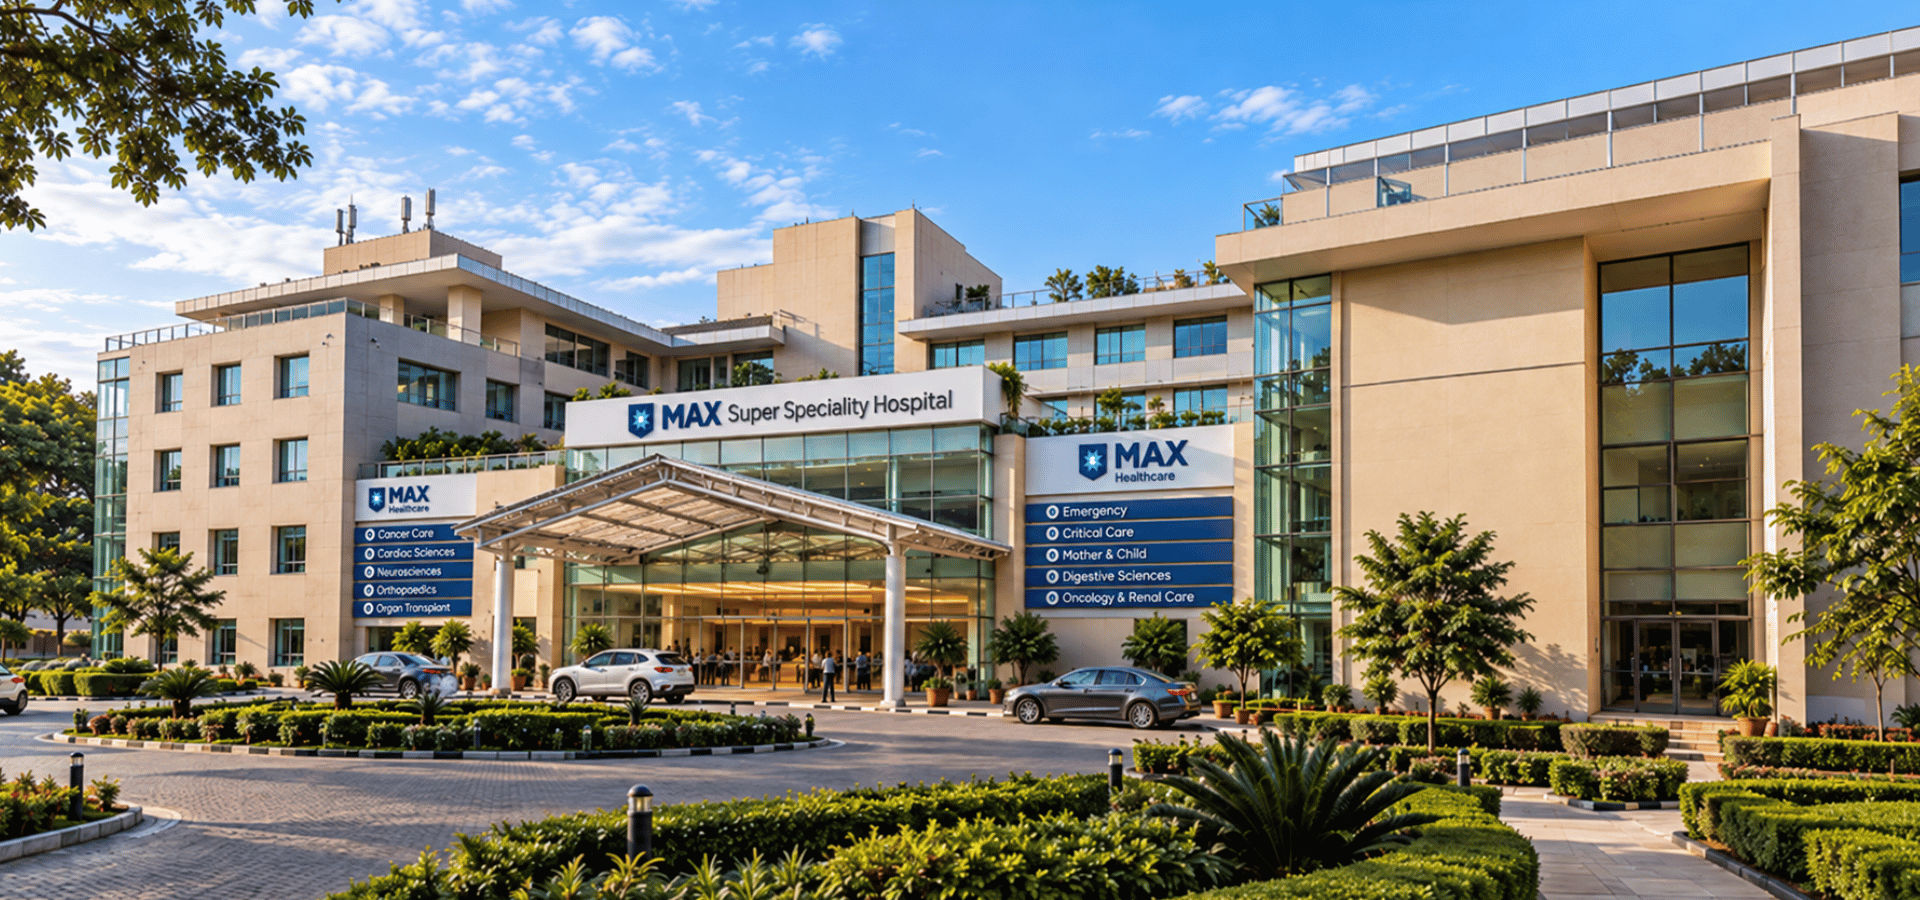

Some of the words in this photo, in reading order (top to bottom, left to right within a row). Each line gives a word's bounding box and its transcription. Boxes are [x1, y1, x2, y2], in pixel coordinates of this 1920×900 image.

[662, 400, 722, 430] MAX
[728, 403, 780, 425] Super
[784, 396, 870, 422] Speciality
[873, 390, 952, 415] Hospital
[1115, 440, 1188, 469] MAX
[1115, 471, 1175, 483] Healthcare
[389, 485, 430, 503] MAX
[389, 505, 429, 513] Healthcare
[1063, 505, 1128, 519] Emergency
[377, 529, 410, 540] Cancer
[411, 528, 434, 539] Care
[1063, 527, 1103, 539] Critical
[1105, 526, 1134, 538] Care
[377, 548, 413, 559] Cardiac
[414, 547, 455, 558] Sciences
[1063, 549, 1102, 561] Mother
[1105, 549, 1114, 560] &
[1116, 548, 1147, 559] Child
[377, 566, 442, 578] Neurosciences
[1063, 570, 1115, 585] Digestive
[1117, 569, 1172, 582] Sciences
[376, 584, 437, 597] Orthopaedics
[1062, 592, 1115, 606] Oncology
[1117, 592, 1125, 603] &
[1128, 591, 1162, 603] Renal
[1164, 591, 1195, 602] Care
[376, 603, 404, 616] Organ
[405, 602, 451, 616] Transplant
